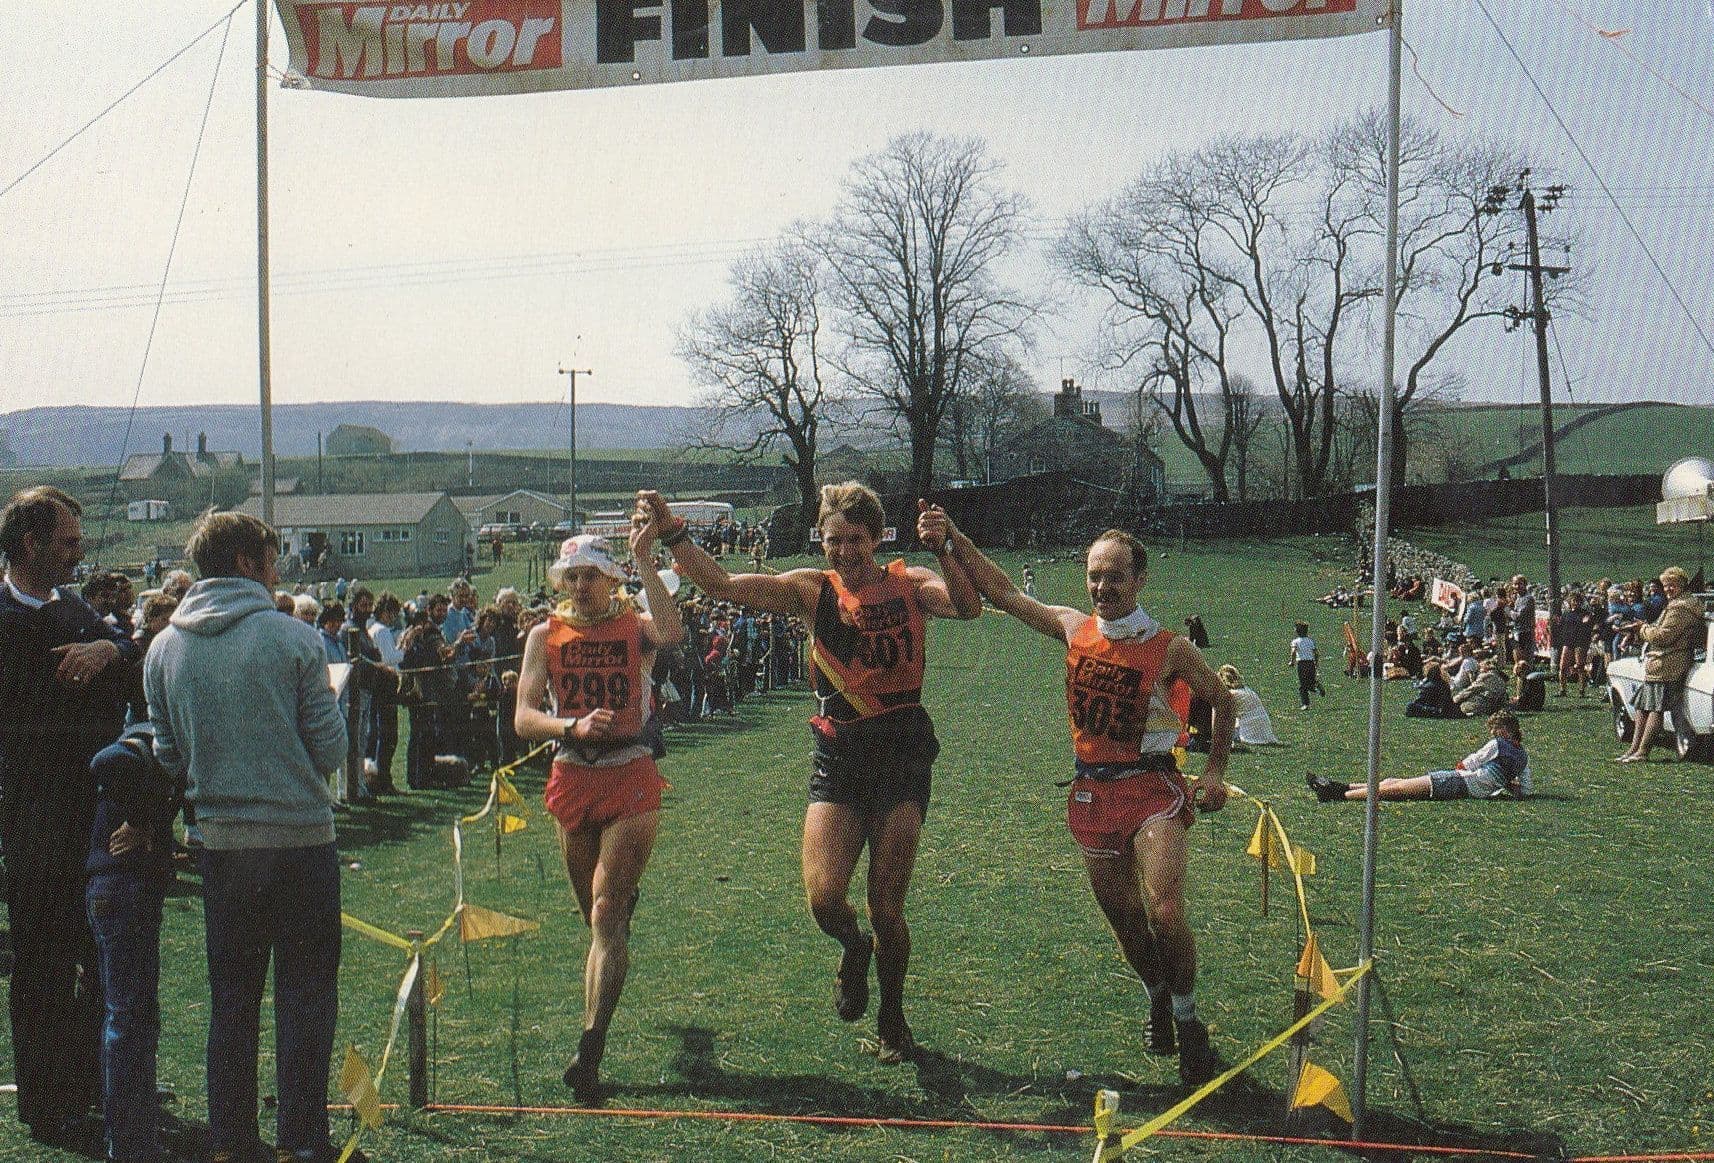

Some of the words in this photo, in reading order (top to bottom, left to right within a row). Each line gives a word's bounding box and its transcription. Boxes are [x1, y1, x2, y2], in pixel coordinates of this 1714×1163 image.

[390, 2, 470, 20] DAILY
[315, 6, 556, 79] Mirror
[561, 671, 629, 710] 299
[1073, 689, 1136, 742] 303
